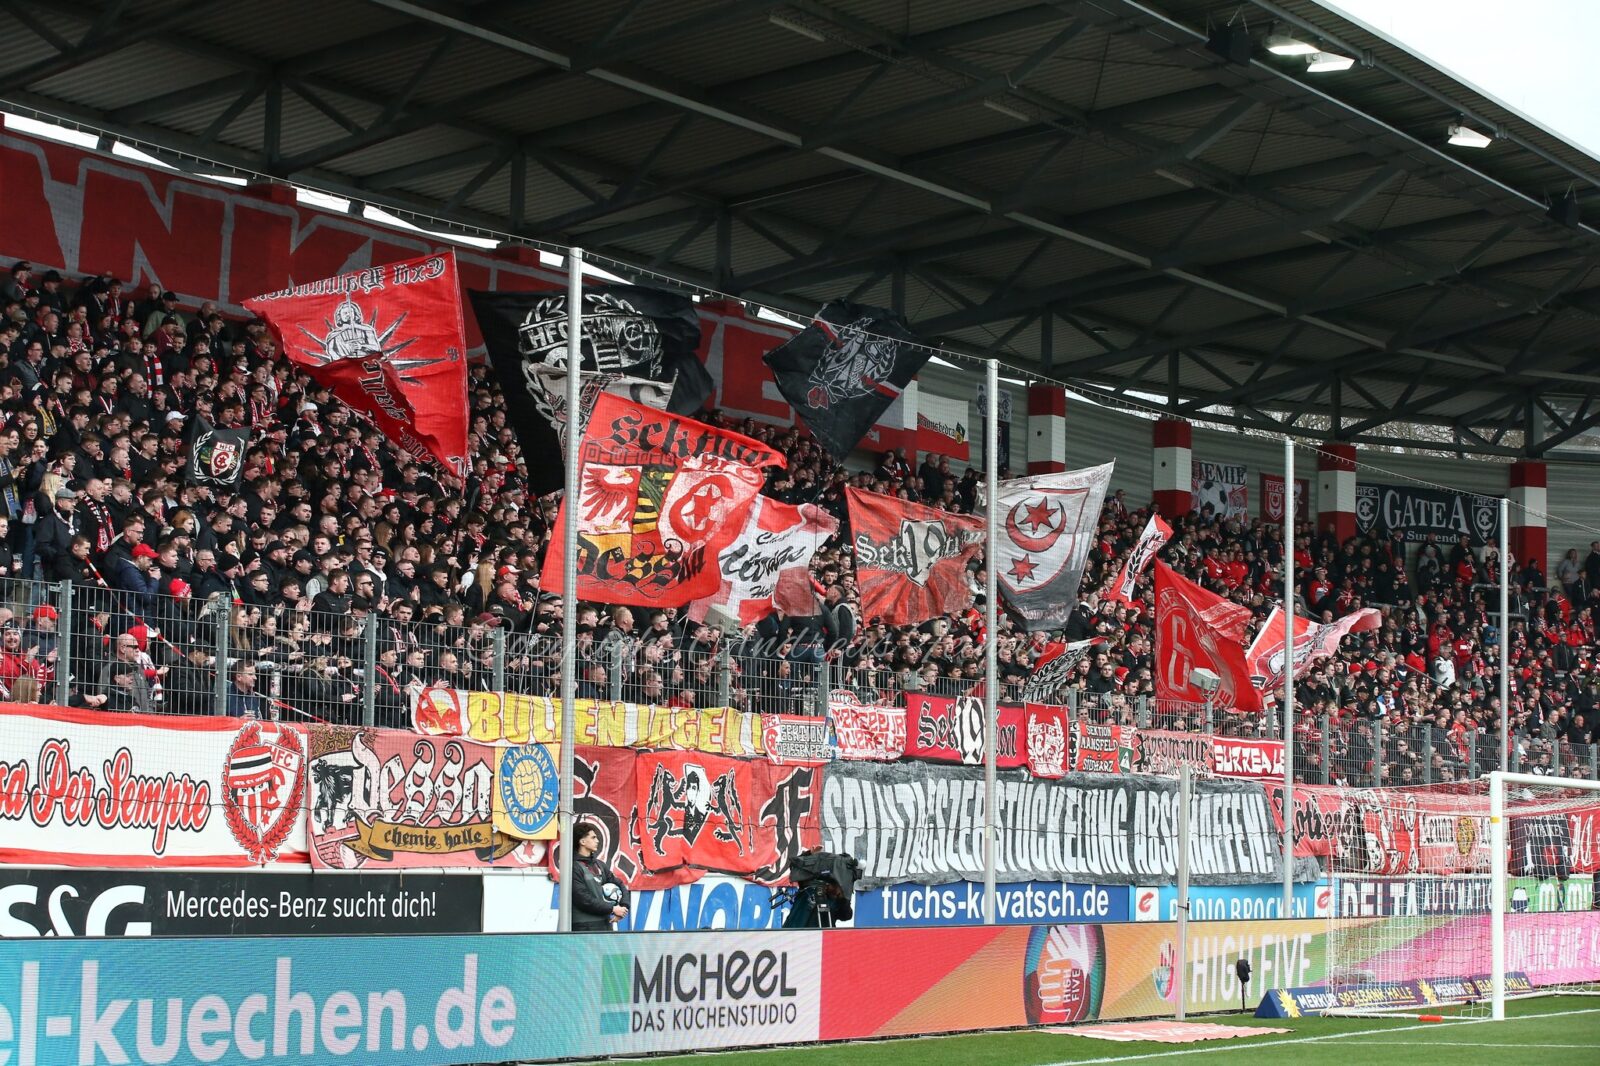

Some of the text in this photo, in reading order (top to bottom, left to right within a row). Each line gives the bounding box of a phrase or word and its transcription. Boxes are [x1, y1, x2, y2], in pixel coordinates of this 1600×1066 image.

[1200, 463, 1247, 486] EMIE
[1384, 489, 1471, 535] GATE A
[1406, 529, 1461, 544] Surende
[1086, 725, 1112, 737] SEKTION
[31, 737, 96, 828] Per
[97, 746, 211, 857] Sempre
[383, 825, 440, 849] chemie
[166, 889, 326, 919] Mercedes-Benz
[333, 889, 385, 918] sucht
[391, 891, 437, 918] dich!
[1341, 881, 1419, 918] DELTA
[1190, 932, 1313, 1004] HIGH FIVE
[1062, 968, 1072, 1004] HIGH
[1071, 967, 1081, 1002] FIVE
[1434, 977, 1531, 998] MERKUR SPIELBA-HALLE
[1296, 992, 1338, 1010] MERKUR
[631, 1001, 798, 1034] DAS KÜCHENSTUDIO
